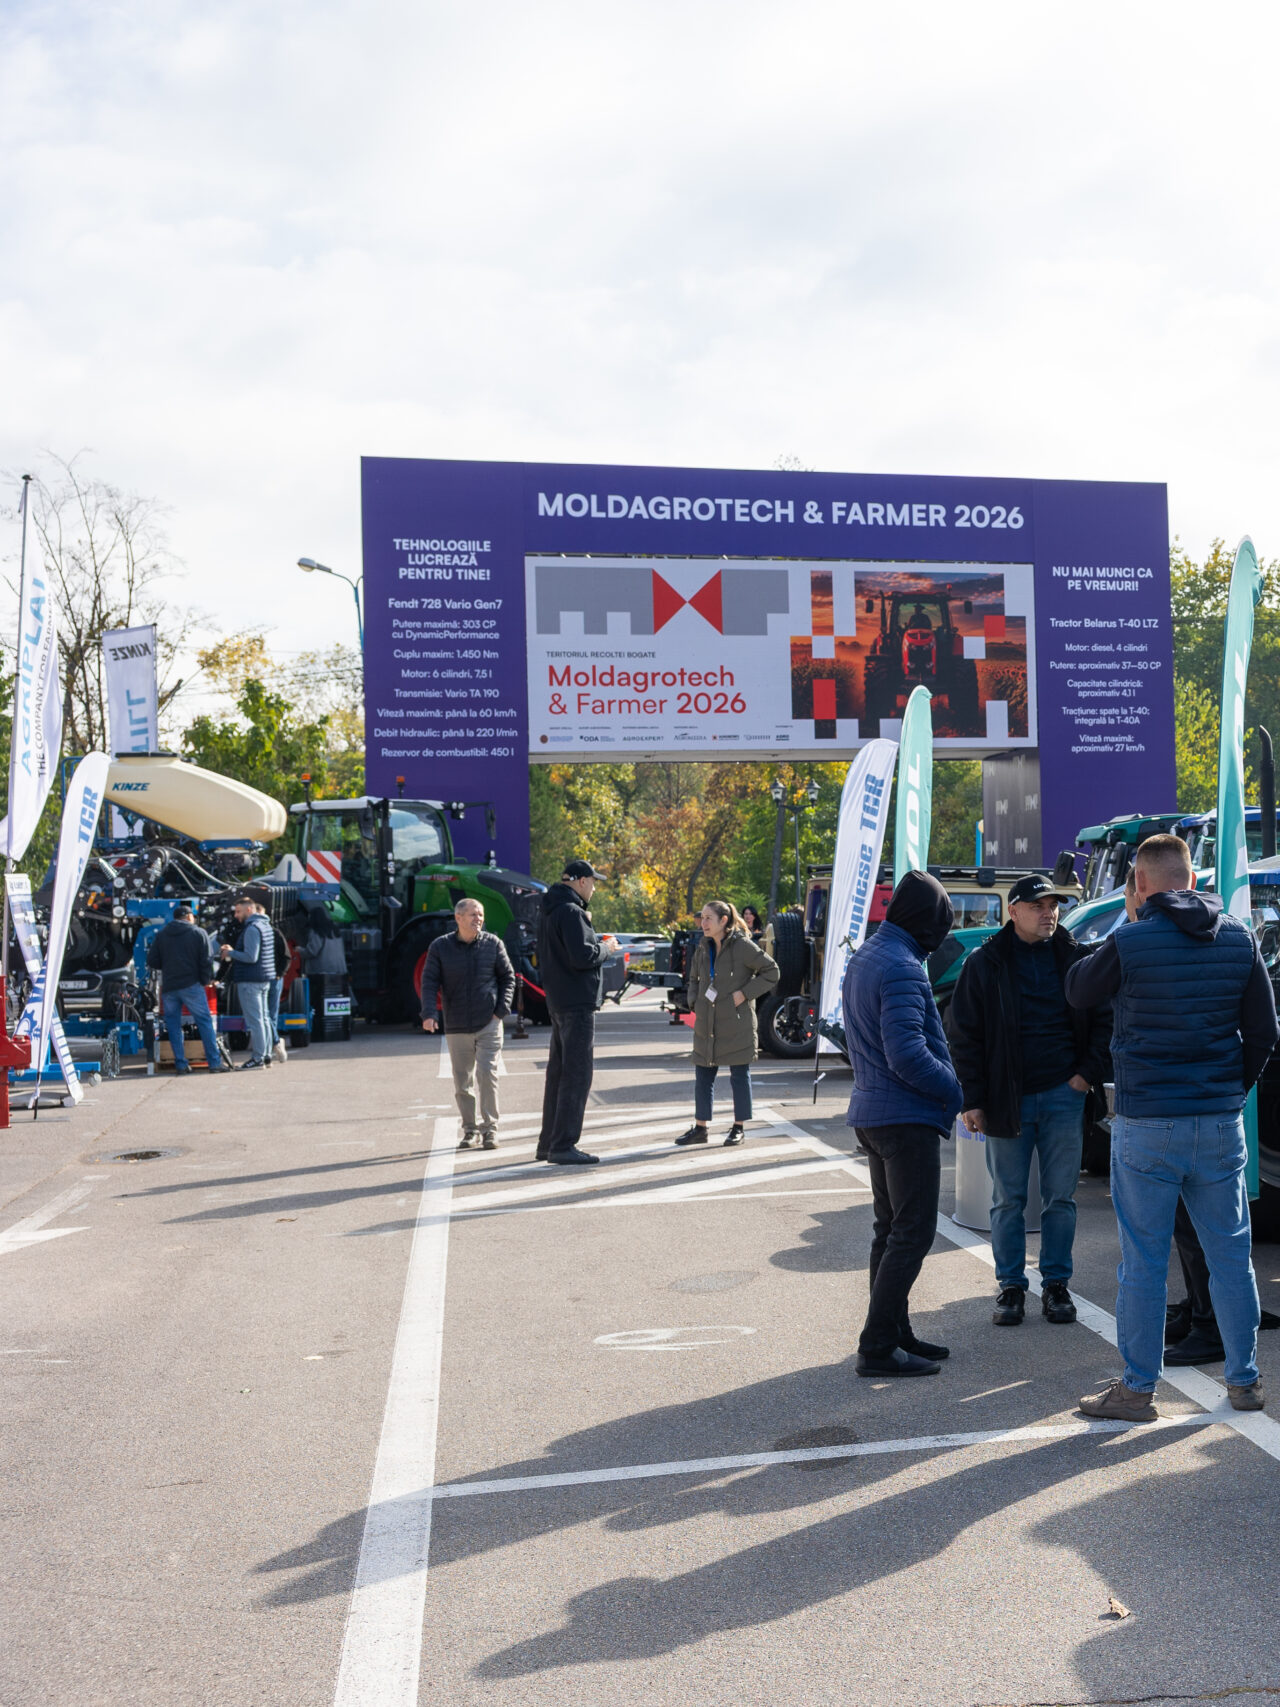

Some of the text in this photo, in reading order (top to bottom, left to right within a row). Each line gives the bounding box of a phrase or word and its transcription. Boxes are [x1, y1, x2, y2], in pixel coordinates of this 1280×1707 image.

[538, 491, 1025, 529] MOLDAGROTECH & FARMER 2026
[393, 538, 492, 552] TEHNOLOGIILE
[408, 552, 478, 566] LUCREAZĂ
[399, 568, 491, 581] PENTRU TINE!
[1052, 566, 1153, 578] NU MAI MUNCI CA
[1068, 580, 1139, 591] PE VREMURI!
[388, 598, 503, 609] Fendt 728 Vario Gen7
[392, 619, 497, 629] Putere maximă: 303 CP
[1050, 617, 1159, 629] Tractor Belarus T-40 LTZ
[406, 630, 500, 641] DynamicPerformance
[1065, 643, 1090, 651] Motor:
[1091, 643, 1115, 652] diesel,
[1123, 643, 1148, 652] cilindri
[393, 649, 499, 661] Cuplu maxim: 1.450 Nm
[1050, 661, 1076, 669] Putere:
[1078, 661, 1120, 671] aproximativ
[402, 669, 430, 678] Motor:
[432, 669, 439, 678] 6
[441, 669, 473, 679] cilindri,
[475, 670, 488, 679] 7,5
[548, 664, 735, 693] Moldagrotech
[1067, 679, 1143, 688] Capacitate cilindrică:
[394, 689, 499, 698] Transmisie: Vario TA 190
[1078, 689, 1120, 699] aproximativ
[548, 692, 747, 715] & Farmer 2026
[33, 683, 46, 751] COMPANY
[377, 708, 517, 720] Viteză maximă: până la 60 km/h
[1099, 707, 1119, 717] spate
[1120, 707, 1127, 715] la
[1129, 707, 1150, 716] T-40;
[1074, 716, 1140, 727] integrală la T-40A
[374, 728, 518, 739] Debit hidraulic: până la 220 l/min
[1079, 734, 1134, 742] Viteză maximă:
[381, 748, 420, 757] Rezervor
[422, 748, 433, 757] de
[435, 747, 488, 757] combustibil:
[490, 748, 509, 757] 450
[1071, 743, 1145, 754] aproximativ 27 km/h
[37, 753, 47, 778] THE
[112, 782, 150, 791] KINZE
